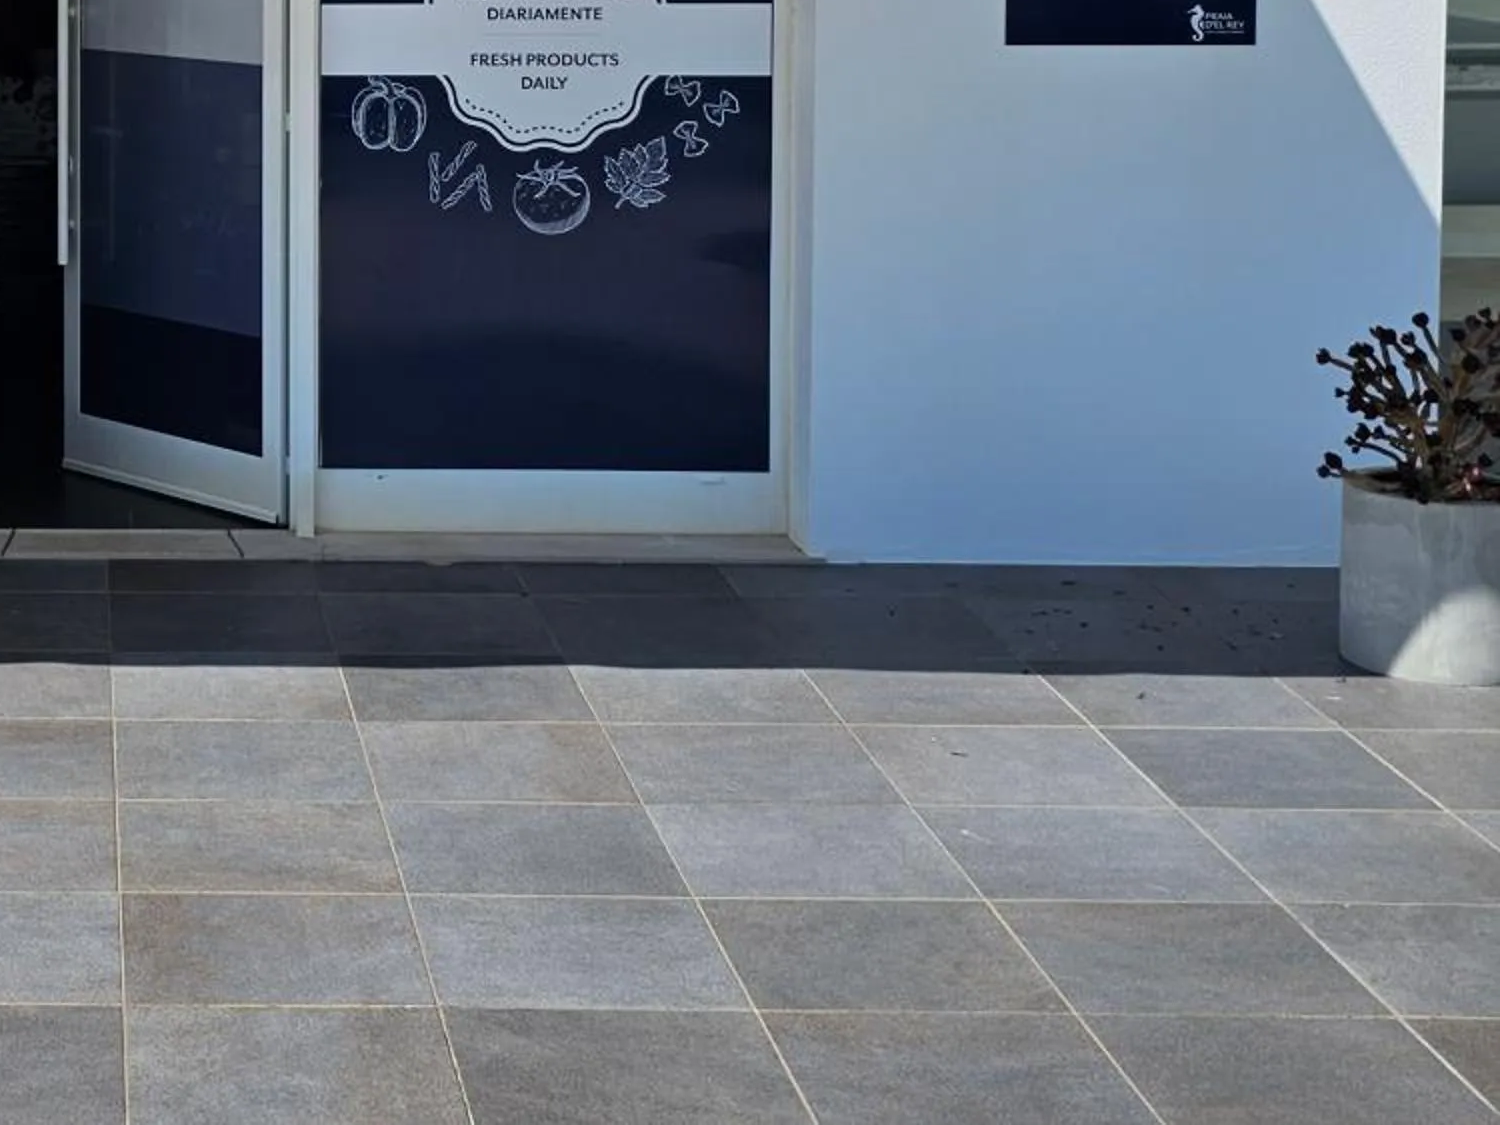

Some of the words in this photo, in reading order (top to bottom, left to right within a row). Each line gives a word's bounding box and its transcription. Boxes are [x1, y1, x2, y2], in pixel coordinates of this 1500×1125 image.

[487, 6, 604, 21] DIARIAMENTE
[470, 53, 522, 67] FRESH
[526, 52, 620, 67] PRODUCTS
[521, 76, 568, 90] DAILY
